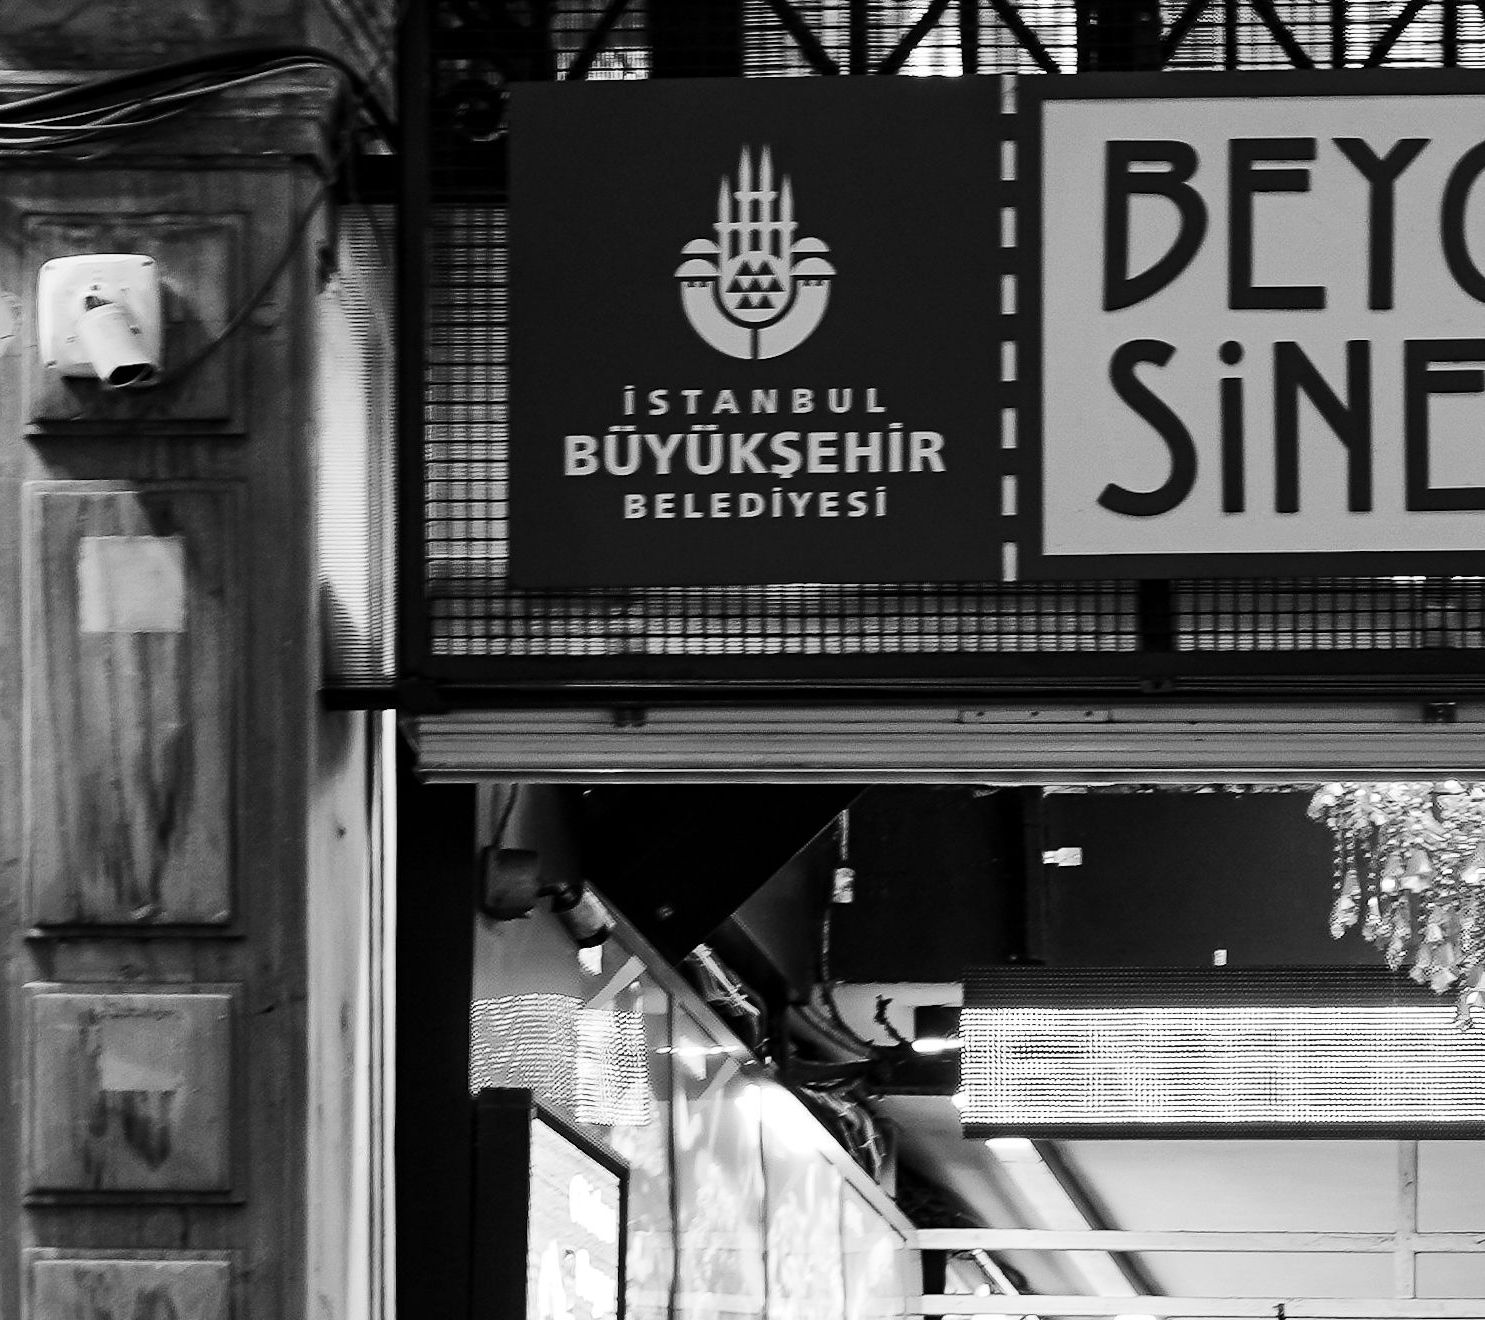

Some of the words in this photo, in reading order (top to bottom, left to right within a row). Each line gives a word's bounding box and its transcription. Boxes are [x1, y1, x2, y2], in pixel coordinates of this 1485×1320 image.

[623, 384, 887, 414] İSTANBUL
[563, 425, 947, 482] BÜYÜKŞEHİR
[622, 484, 891, 520] BELEDİYESİ
